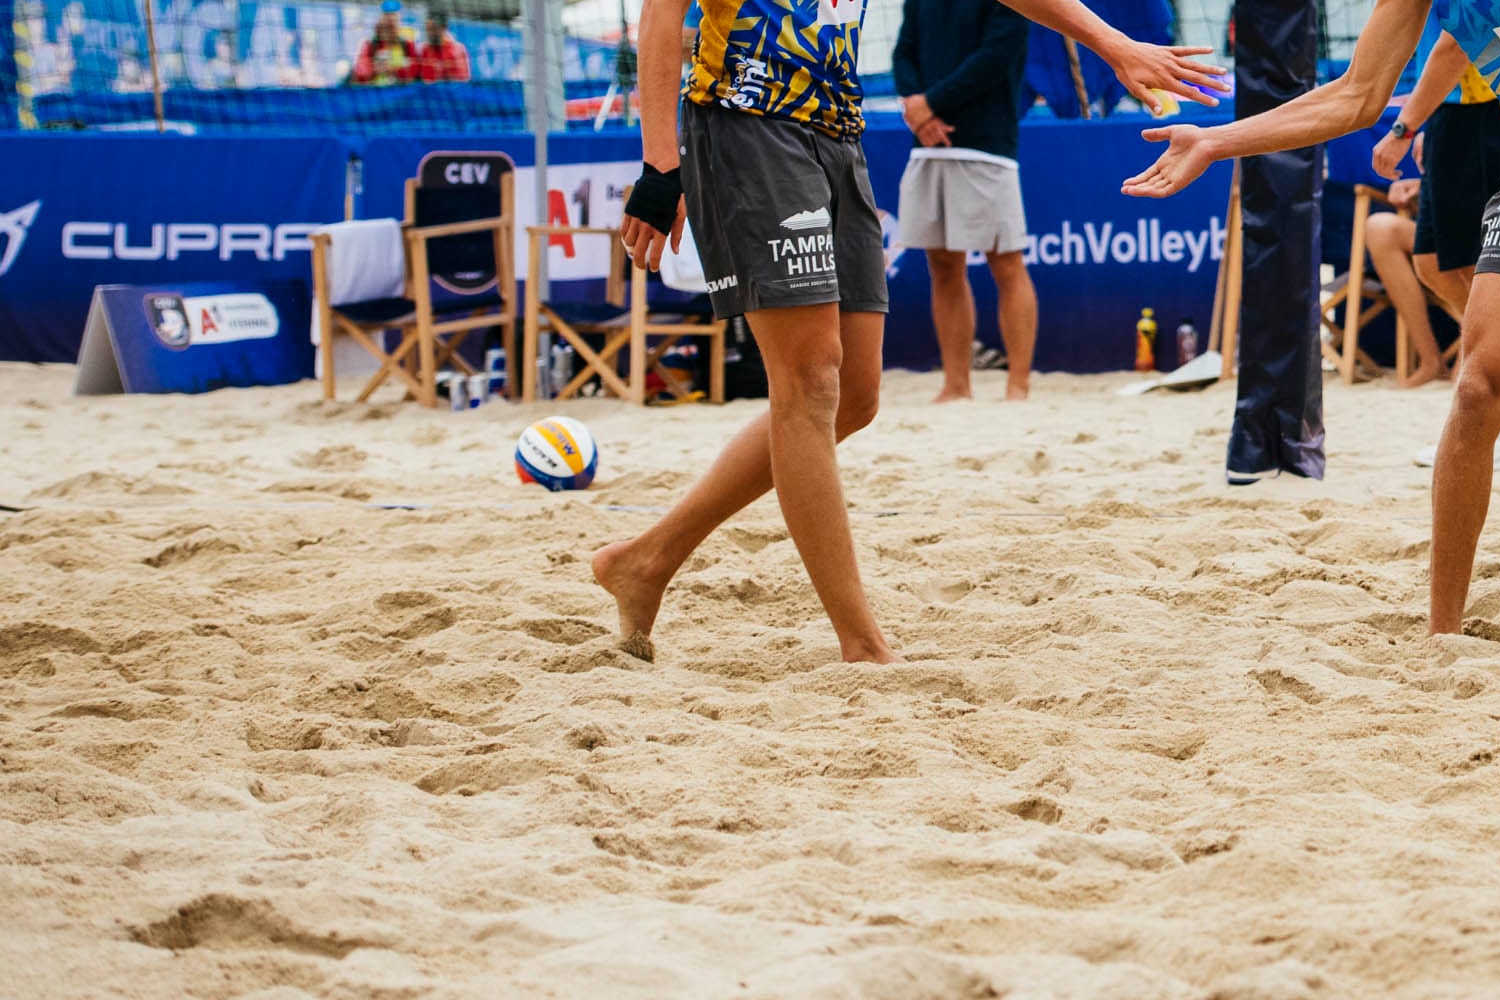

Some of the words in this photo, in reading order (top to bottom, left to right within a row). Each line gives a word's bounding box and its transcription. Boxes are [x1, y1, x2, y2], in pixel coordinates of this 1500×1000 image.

[444, 162, 490, 184] CEV
[767, 234, 833, 262] TAMPA
[966, 216, 1228, 272] achVolleyb
[787, 253, 836, 275] HILLS
